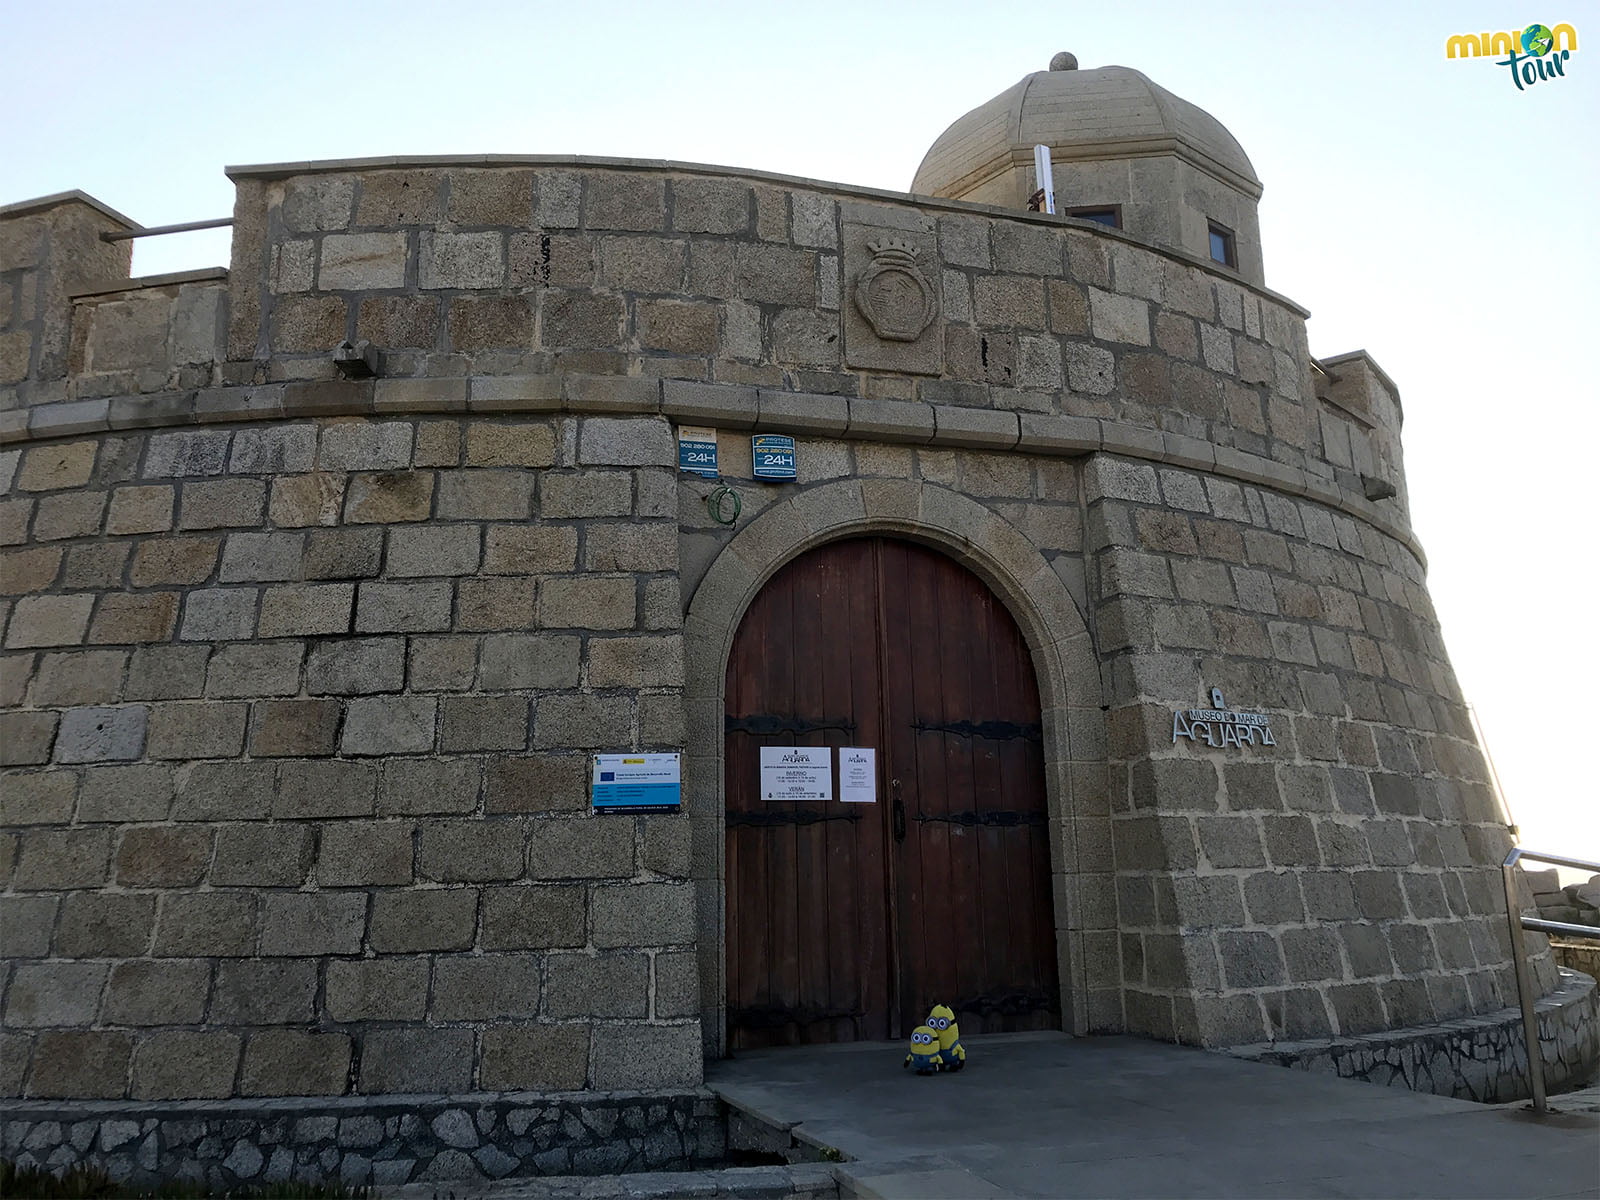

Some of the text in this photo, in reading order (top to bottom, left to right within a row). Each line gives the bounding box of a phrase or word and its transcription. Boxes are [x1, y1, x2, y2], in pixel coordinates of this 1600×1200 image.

[687, 452, 716, 463] 24H
[764, 454, 793, 466] 24H
[1189, 710, 1223, 721] MUSEO
[1237, 713, 1256, 724] MAR
[1172, 709, 1277, 748] AGUARDA
